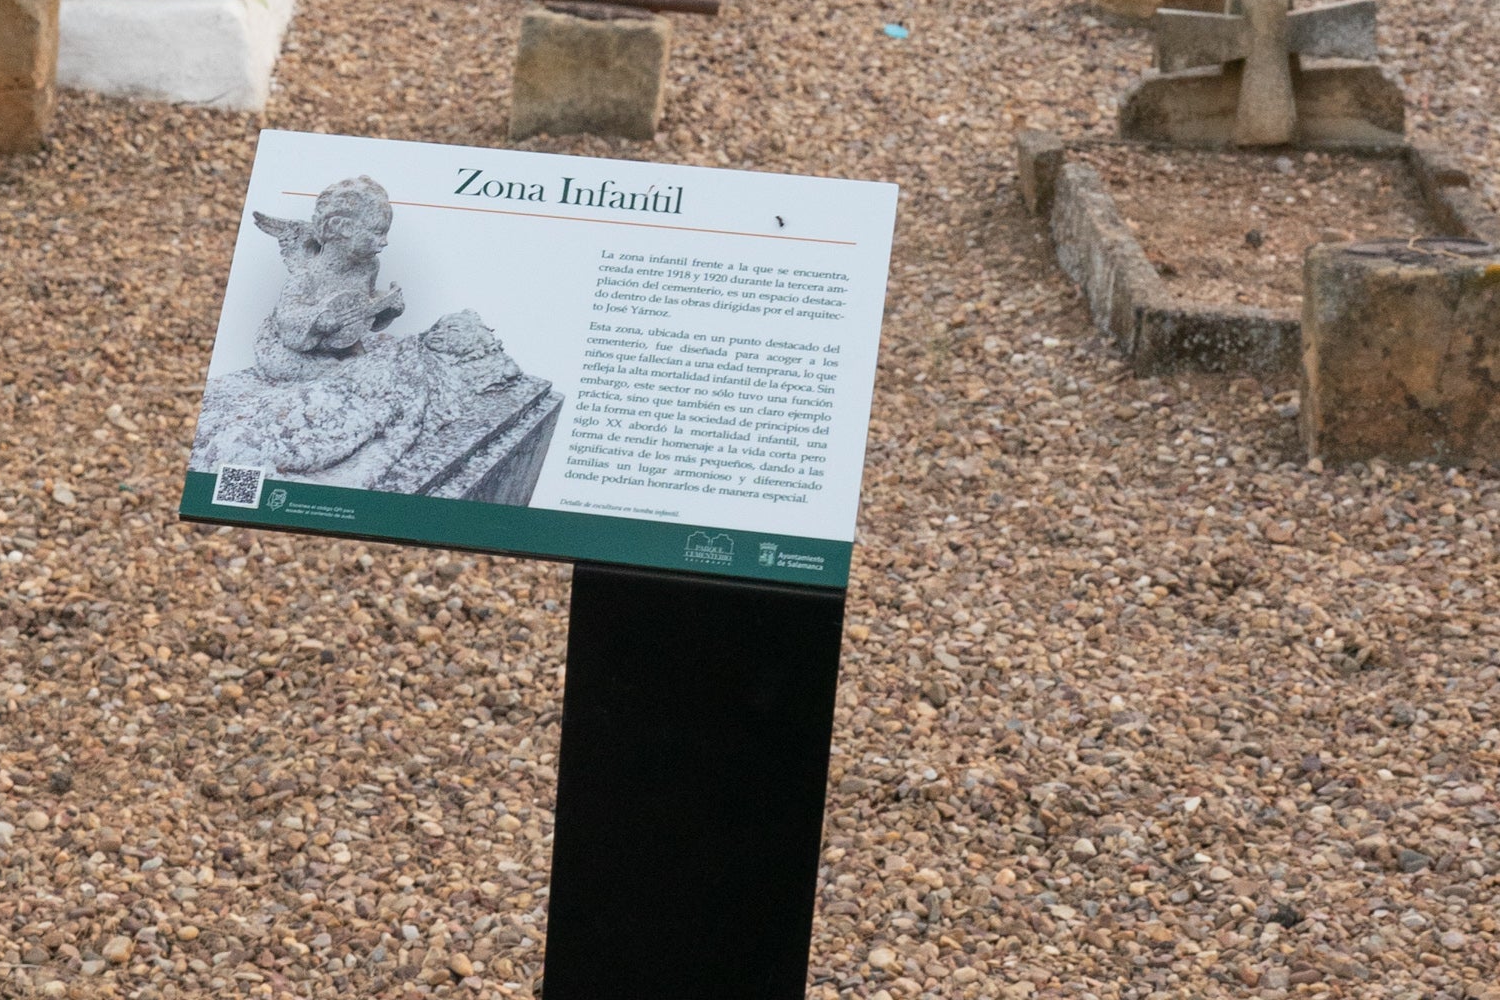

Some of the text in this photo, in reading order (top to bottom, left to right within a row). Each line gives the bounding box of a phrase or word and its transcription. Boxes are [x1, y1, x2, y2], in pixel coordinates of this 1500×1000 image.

[454, 167, 683, 215] Zona Infantil
[598, 264, 633, 274] creada
[636, 268, 664, 277] entre
[667, 269, 691, 279] 1918
[692, 273, 700, 282] y
[703, 272, 728, 282] 1920
[729, 274, 772, 287] durante
[774, 278, 784, 288] la
[787, 281, 824, 291] tercera
[601, 249, 614, 259] La
[618, 253, 644, 262] zona
[648, 254, 687, 266] infantil
[691, 257, 723, 269] frente
[738, 262, 748, 271] la
[752, 265, 773, 275] que
[792, 269, 849, 281] encuentra,
[594, 288, 844, 320] do dentro de las obras dirigidas por el arquitec-
[596, 276, 639, 287] pliación
[641, 280, 659, 289] del
[661, 284, 724, 296] cementerio,
[758, 293, 799, 303] espacio
[801, 295, 846, 306] destaca-
[592, 302, 670, 317] to José Yárnoz.
[586, 336, 647, 349] cementerio,
[655, 341, 673, 351] fue
[679, 343, 727, 356] diseñada
[734, 351, 759, 360] para
[766, 354, 802, 365] acoger
[822, 357, 838, 367] los
[589, 321, 611, 331] Esta
[614, 326, 643, 335] zona,
[647, 327, 689, 339] ubicada
[693, 333, 706, 341] en
[728, 337, 761, 346] punto
[764, 338, 819, 351] destacado
[822, 343, 840, 353] del
[582, 362, 834, 394] refleja la alta mortalidad infantil de la época. Sin
[584, 348, 613, 358] niños
[615, 353, 636, 362] que
[638, 353, 683, 365] fallecían
[694, 360, 714, 368] una
[716, 361, 743, 371] edad
[746, 364, 800, 378] temprana,
[803, 368, 814, 378] lo
[815, 372, 837, 382] que
[577, 389, 622, 401] práctica,
[626, 393, 649, 403] sino
[652, 397, 673, 407] que
[676, 399, 720, 410] también
[757, 406, 784, 416] claro
[787, 409, 832, 423] ejemplo
[579, 376, 629, 389] embargo,
[633, 382, 655, 390] este
[658, 384, 691, 393] sector
[711, 388, 734, 398] sólo
[738, 391, 763, 400] tuvo
[766, 395, 787, 403] una
[791, 395, 833, 408] función
[573, 415, 827, 449] siglo XX abordó la mortalidad infantil, una
[575, 401, 589, 411] de
[591, 402, 601, 412] la
[603, 403, 636, 415] forma
[653, 411, 674, 421] que
[676, 411, 686, 420] la
[688, 414, 736, 425] sociedad
[738, 417, 753, 427] de
[754, 421, 810, 434] principios
[811, 425, 829, 435] del
[568, 442, 633, 456] significativa
[637, 449, 651, 458] de
[654, 450, 670, 460] los
[674, 454, 696, 463] más
[699, 457, 755, 470] pequeños,
[758, 461, 795, 473] dando
[808, 466, 824, 476] las
[571, 428, 603, 440] forma
[606, 432, 621, 441] de
[623, 435, 658, 445] rendir
[661, 437, 714, 453] homenaje
[727, 444, 737, 453] la
[741, 446, 765, 456] vida
[768, 450, 796, 459] corta
[800, 454, 826, 463] pero
[563, 469, 808, 503] donde podrían honrarlos de manera especial.
[566, 455, 609, 468] familias
[638, 462, 667, 476] lugar
[673, 469, 732, 481] armonioso
[738, 475, 746, 485] y
[752, 475, 822, 490] diferenciado
[560, 498, 582, 506] Detalle
[777, 552, 824, 563] Ayuntamiento
[787, 560, 823, 570] Salamanca
